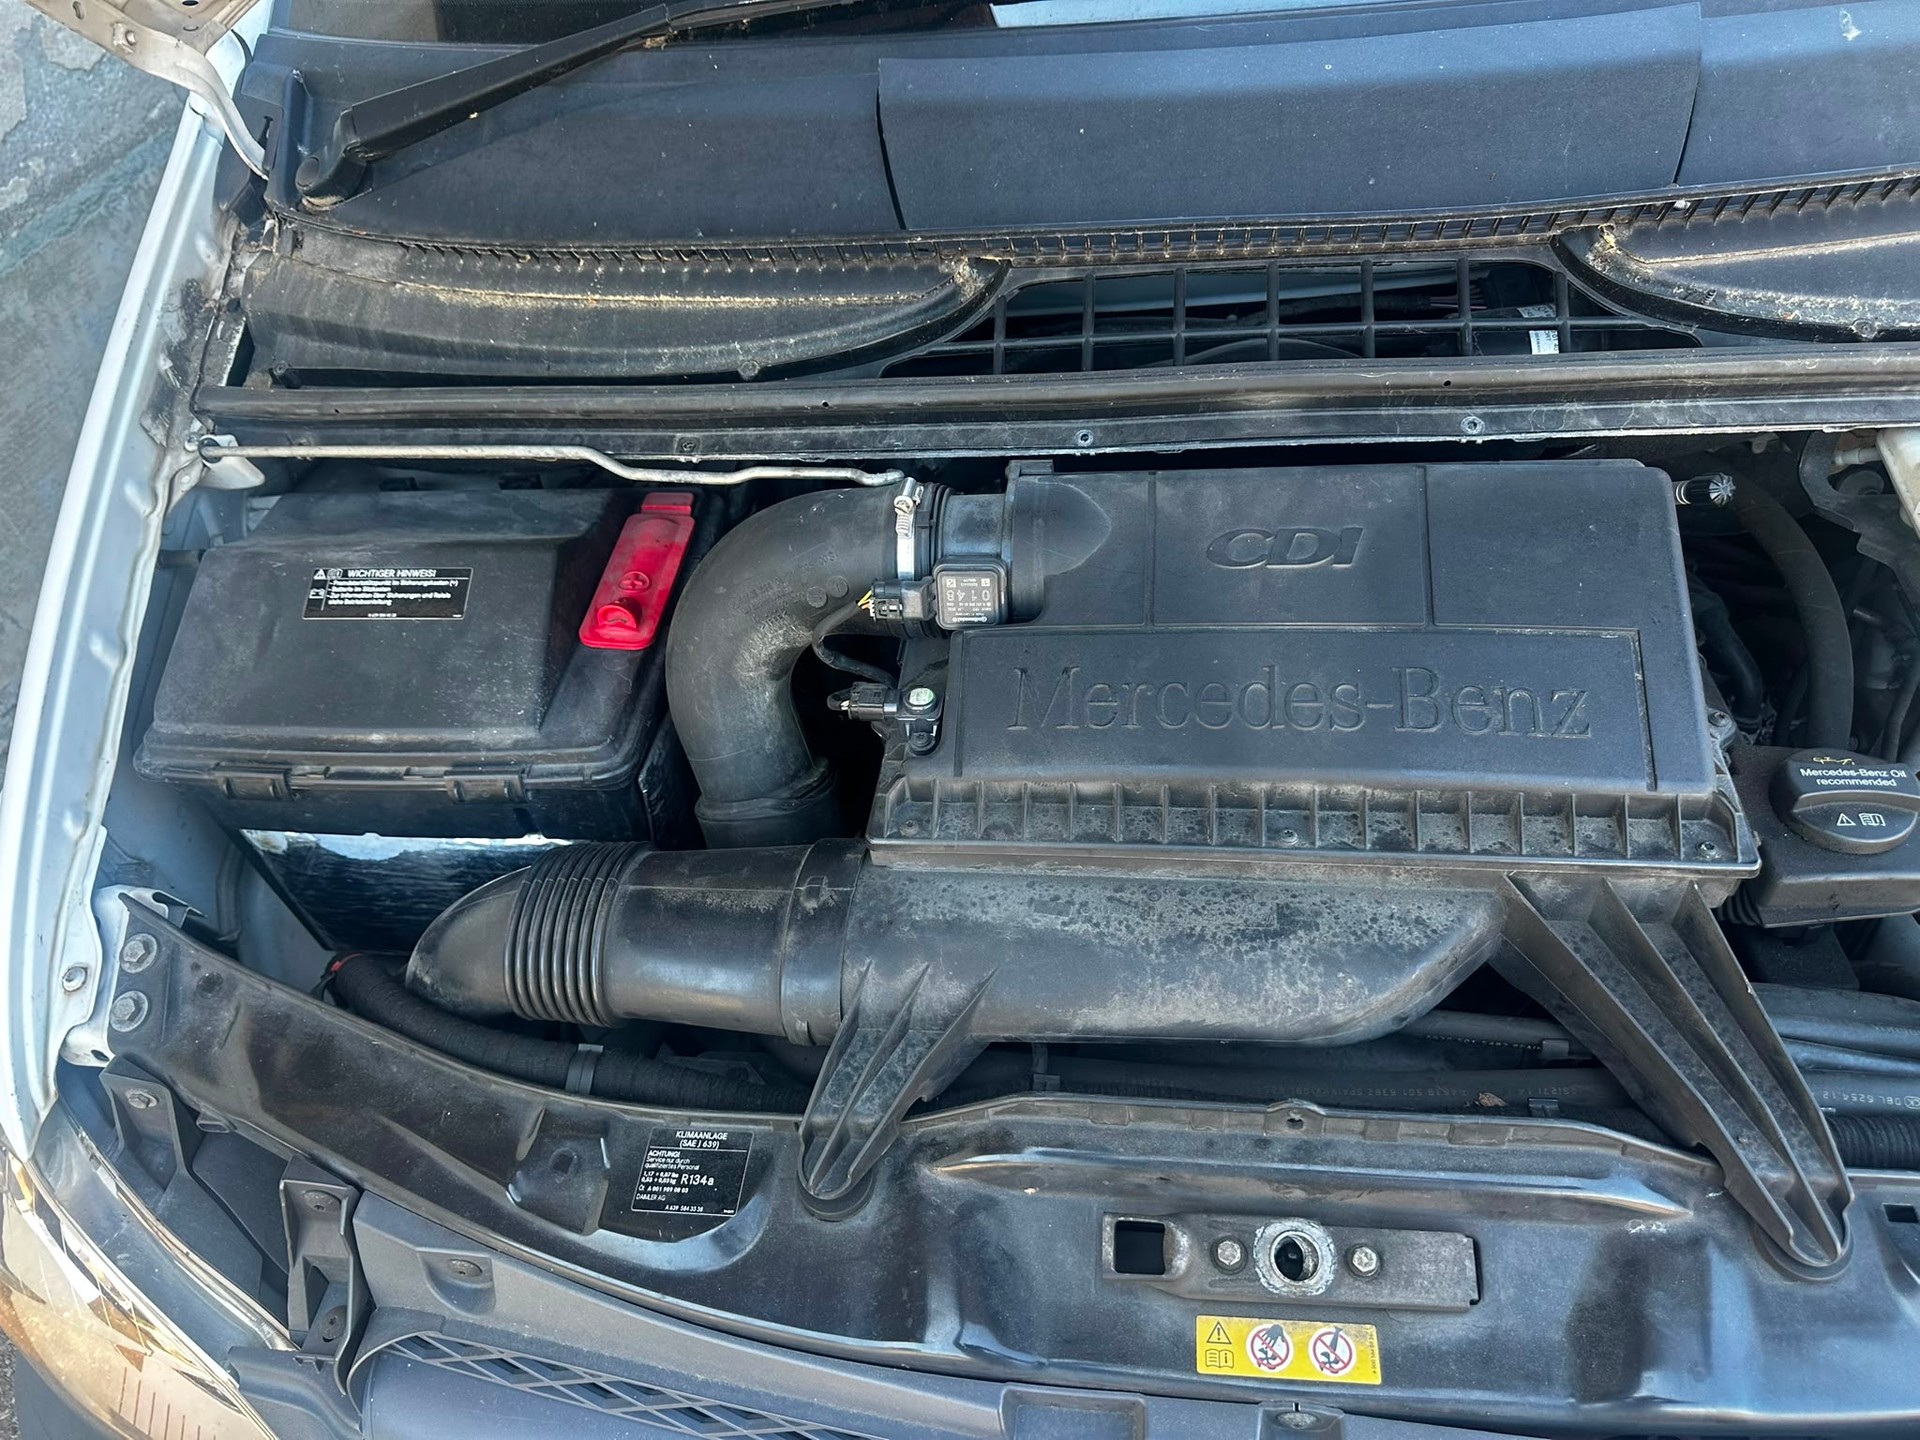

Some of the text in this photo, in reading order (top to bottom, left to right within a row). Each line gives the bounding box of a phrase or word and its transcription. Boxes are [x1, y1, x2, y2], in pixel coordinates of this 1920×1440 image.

[1206, 525, 1365, 569] CDI
[347, 569, 437, 578] WICHTIGER HINWEIS!
[1007, 664, 1592, 738] Mercedes-Benz
[1800, 768, 1907, 778] Mercedes-Benz Oil
[1816, 778, 1897, 787] recommended
[676, 1131, 728, 1140] KLIMAANLAGE
[680, 1139, 697, 1149] (SAE
[648, 1150, 680, 1158] ACHTUNG!
[680, 1173, 715, 1186] R134a
